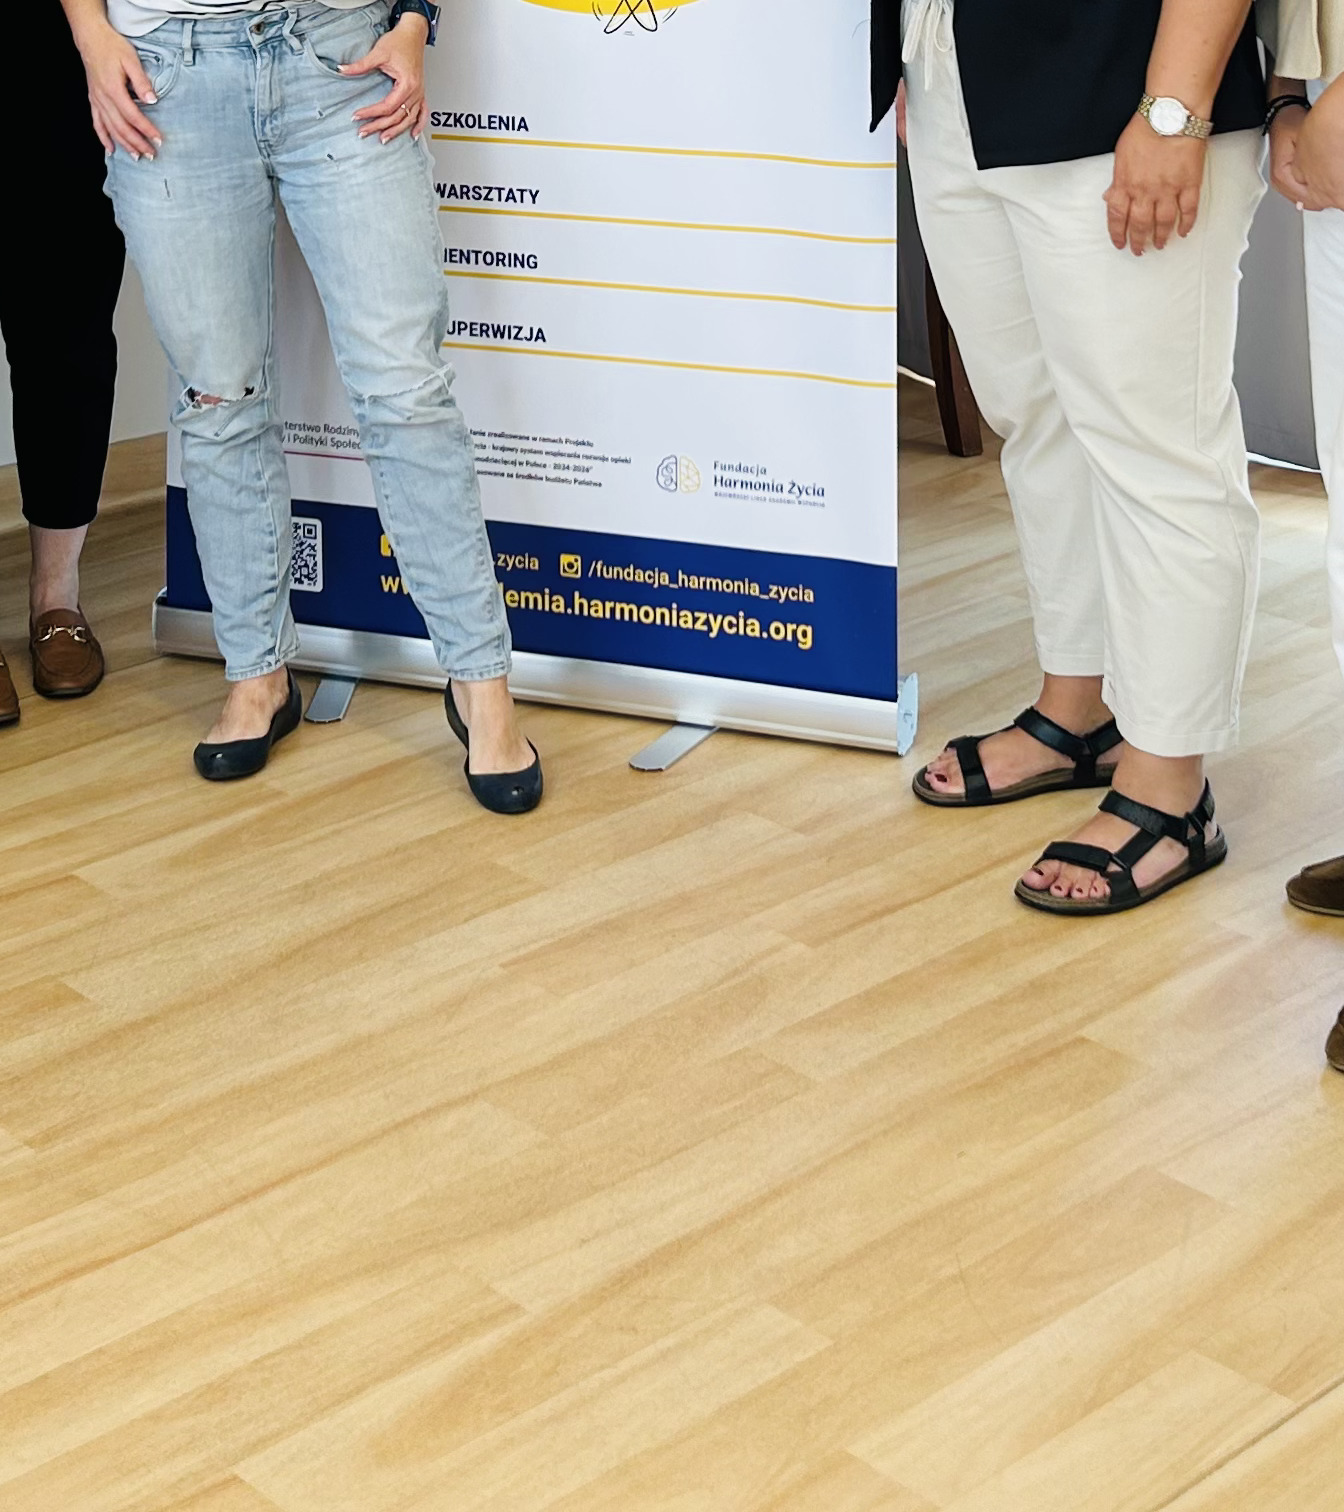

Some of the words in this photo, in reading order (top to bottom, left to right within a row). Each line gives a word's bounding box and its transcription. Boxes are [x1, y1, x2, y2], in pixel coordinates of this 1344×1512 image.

[430, 111, 529, 132] SZKOLENIA
[434, 182, 540, 205] WARSZTATY
[447, 320, 546, 344] UPERWIZJA
[284, 420, 321, 434] terstwo
[713, 460, 768, 478] Fundacja
[713, 474, 785, 495] Harmonia
[787, 479, 826, 500] Życia
[587, 560, 814, 604] /fundacja_harmonia_zycia
